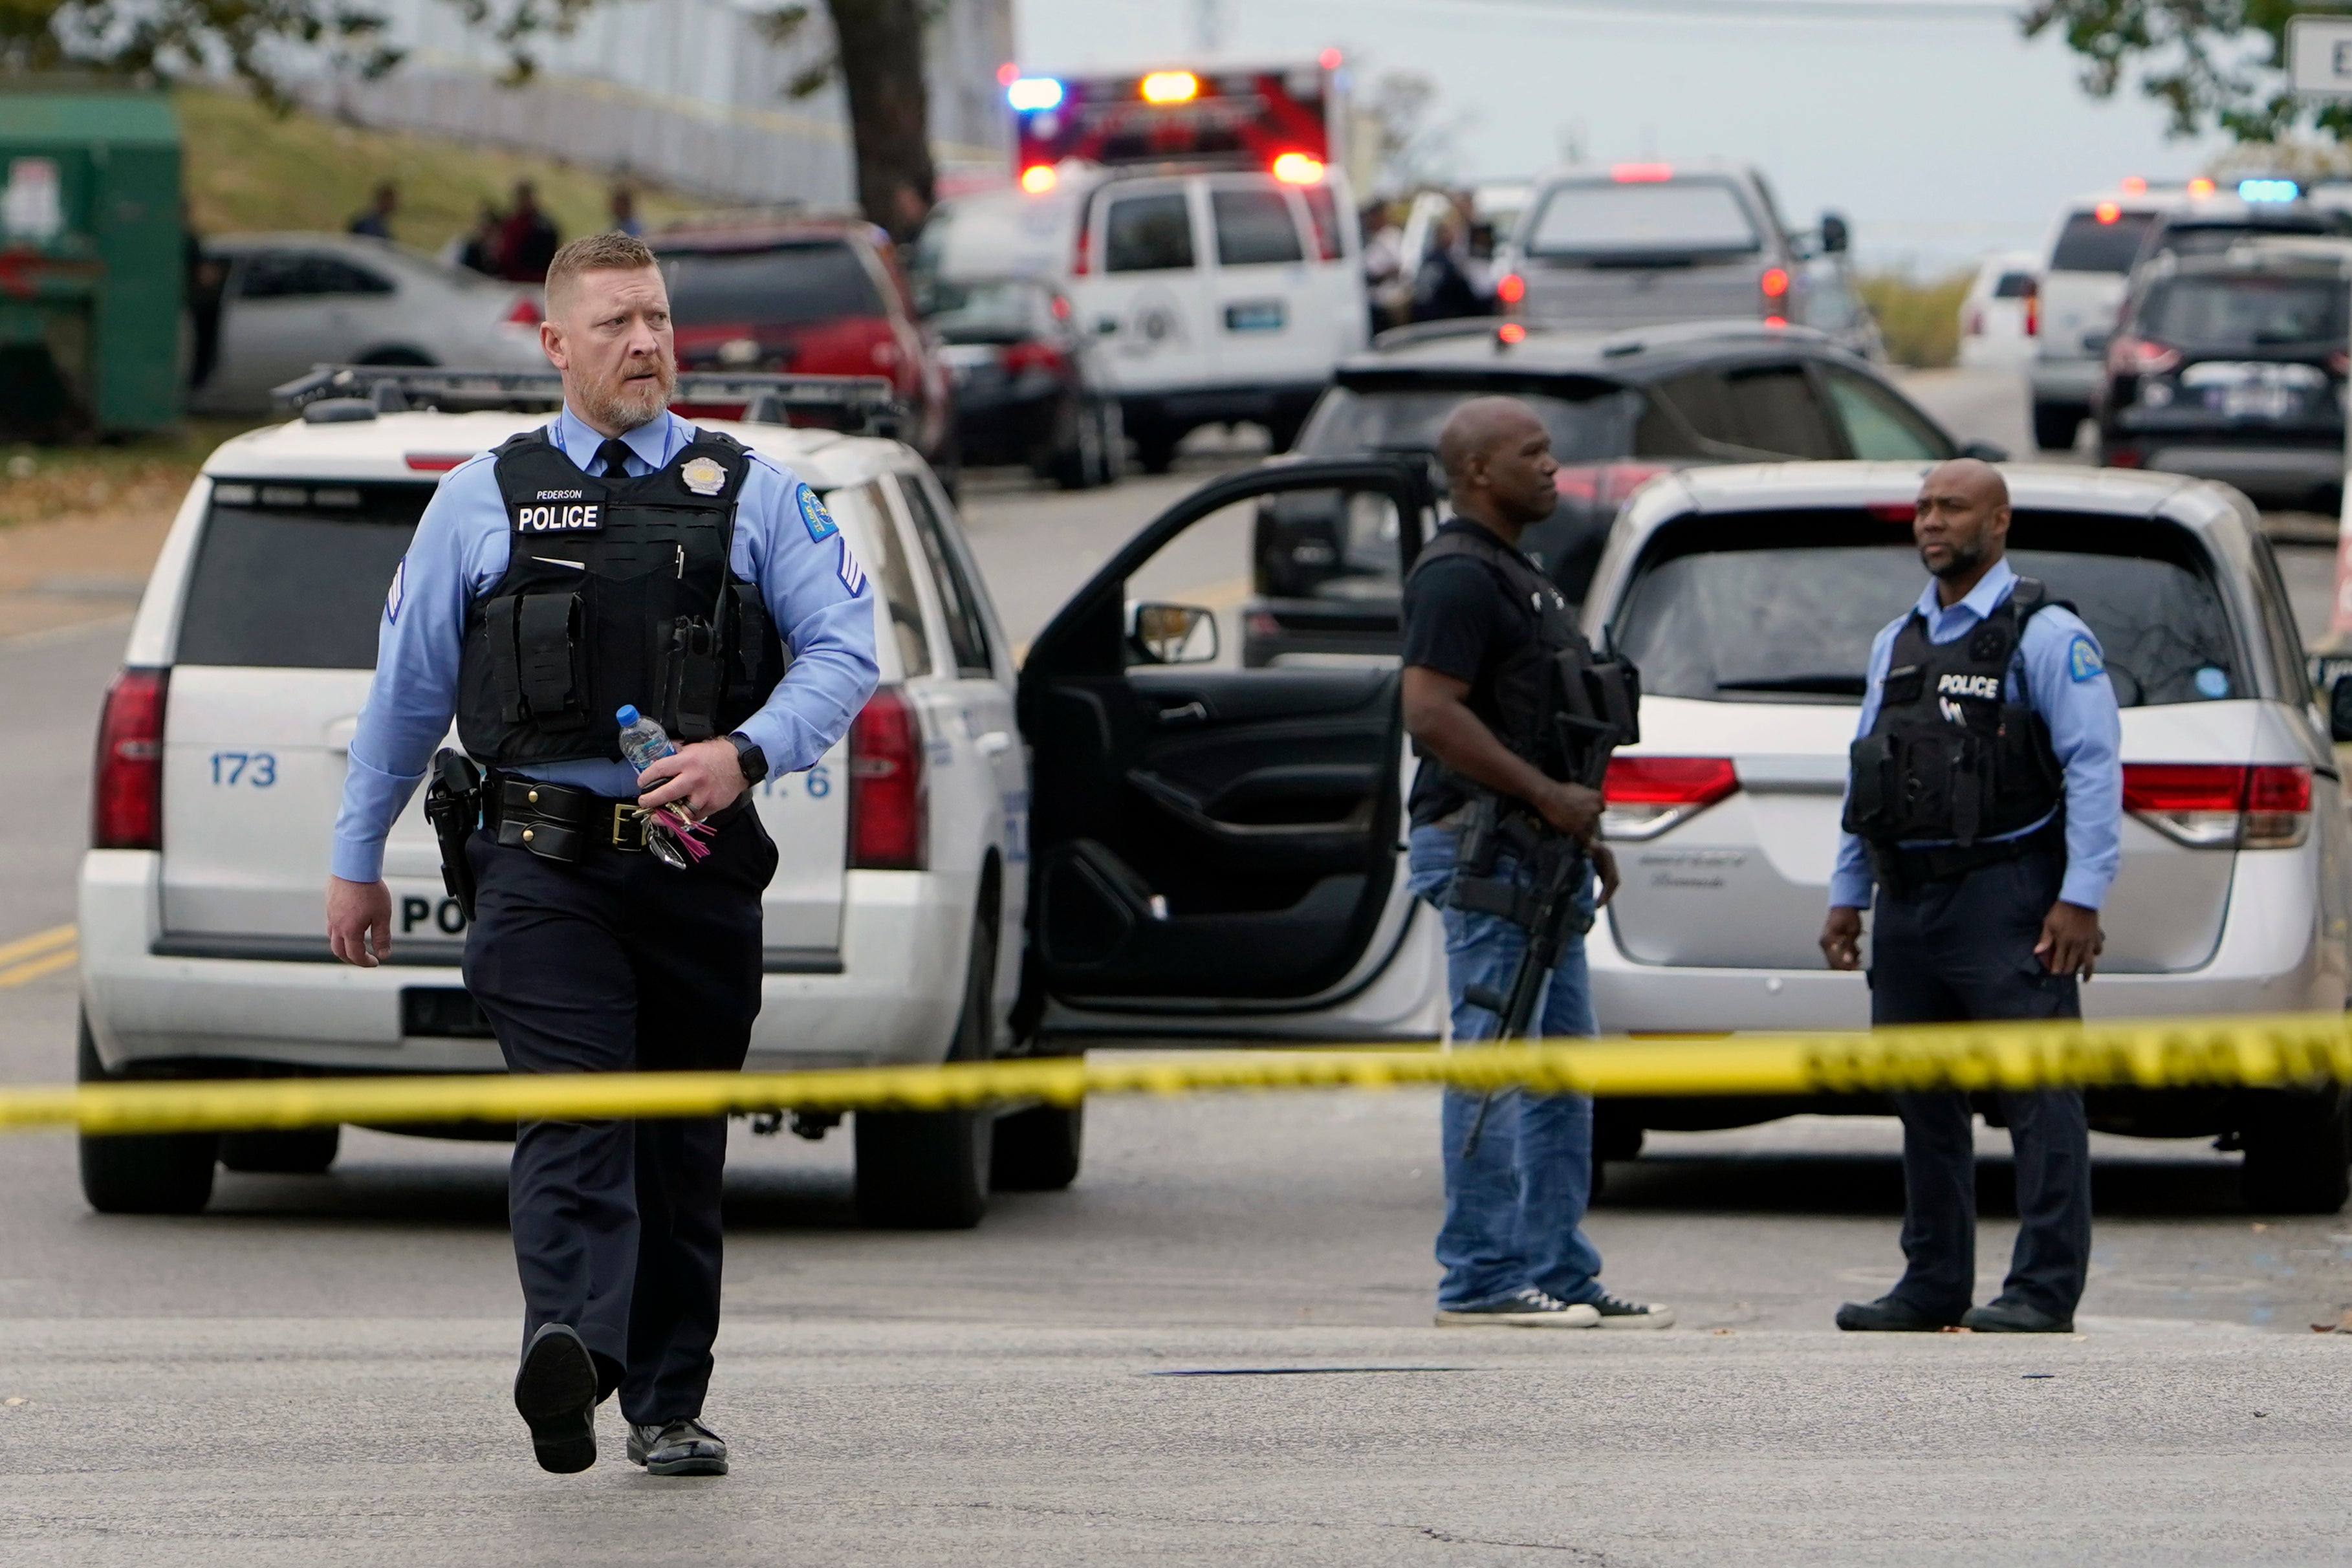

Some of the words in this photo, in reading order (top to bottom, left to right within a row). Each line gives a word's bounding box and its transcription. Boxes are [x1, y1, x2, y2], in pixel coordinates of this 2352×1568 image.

[537, 490, 582, 500] PEDERSON
[519, 505, 598, 531] POLICE
[1937, 674, 1999, 699] POLICE
[211, 752, 276, 787] 173
[807, 767, 830, 798] 6
